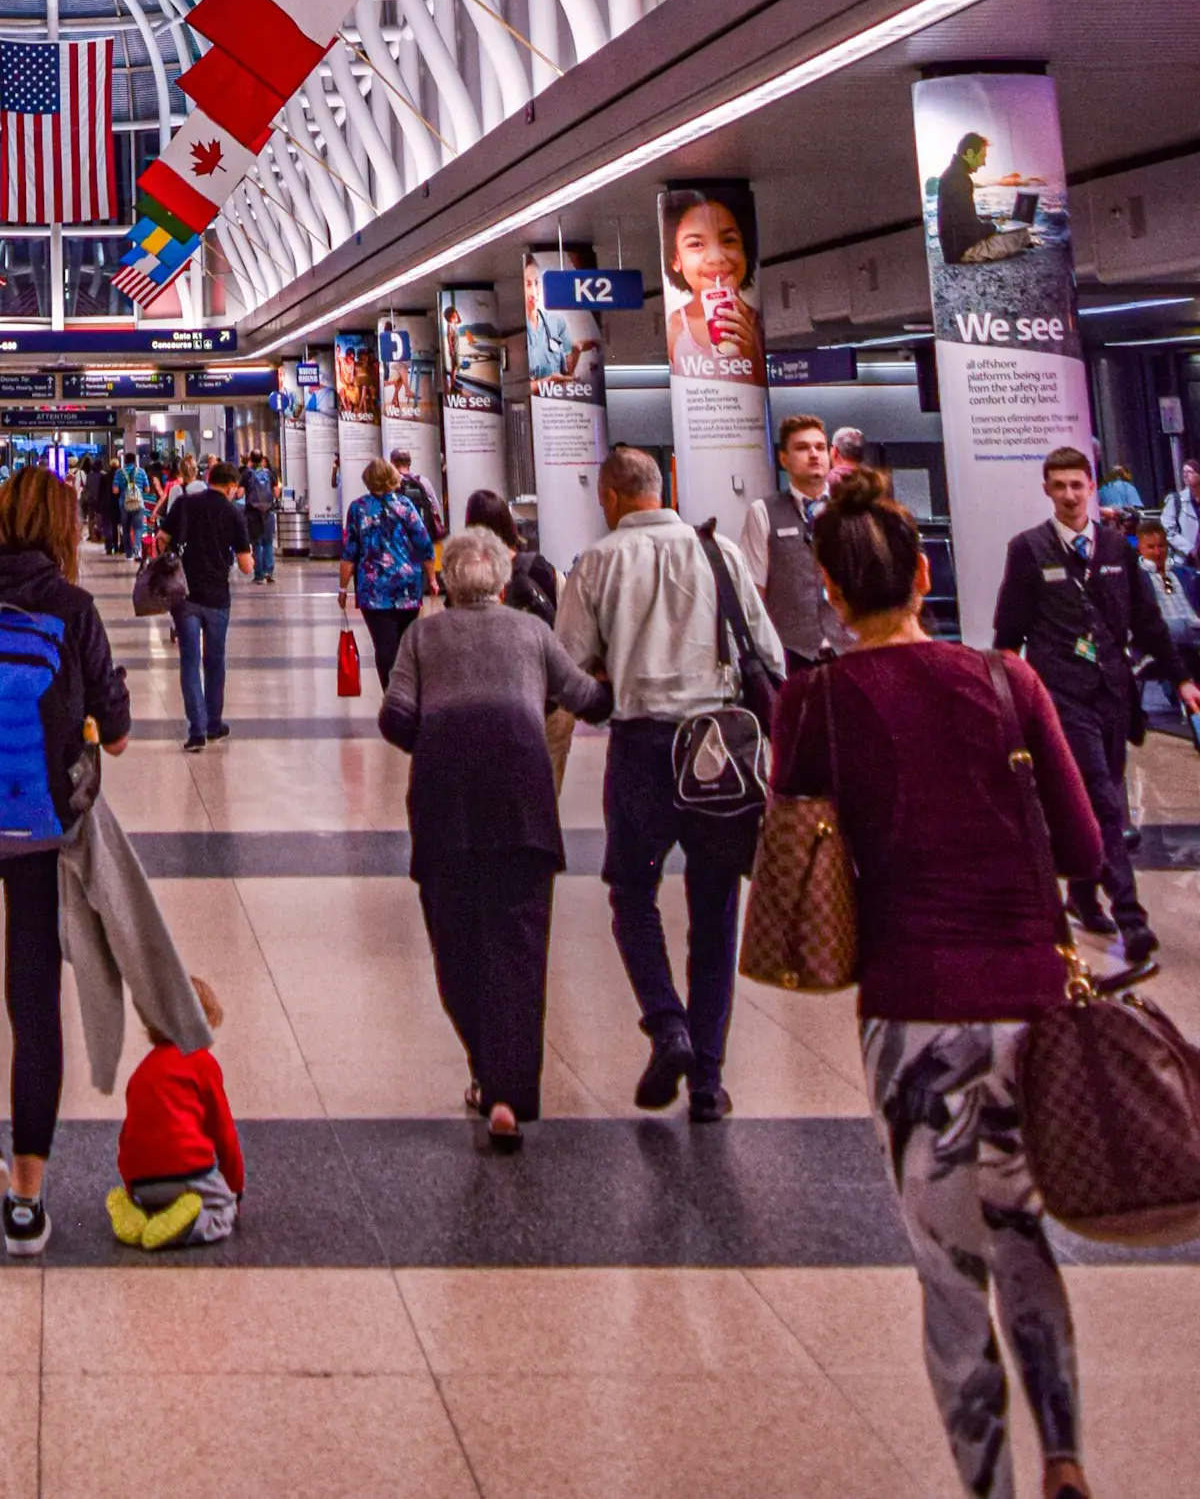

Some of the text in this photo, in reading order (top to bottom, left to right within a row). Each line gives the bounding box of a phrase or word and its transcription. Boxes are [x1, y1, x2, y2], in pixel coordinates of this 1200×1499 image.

[574, 278, 614, 302] K2
[955, 312, 1064, 343] We see
[173, 332, 191, 340] Gate
[151, 341, 192, 350] Concourse
[680, 355, 753, 376] We see
[966, 360, 1017, 369] all offshore
[967, 371, 1012, 382] platforms
[1014, 371, 1041, 381] being
[538, 382, 593, 398] We see
[968, 383, 1058, 393] from the safety and
[447, 394, 491, 408] We see
[969, 394, 1060, 406] comfort of dry land.
[386, 405, 421, 416] We see
[341, 411, 374, 421] We see
[970, 415, 1006, 423] Emerson
[1007, 414, 1050, 423] eliminates
[972, 426, 980, 435] to
[981, 426, 1000, 434] send
[1002, 426, 1032, 436] people
[973, 437, 1002, 445] routine
